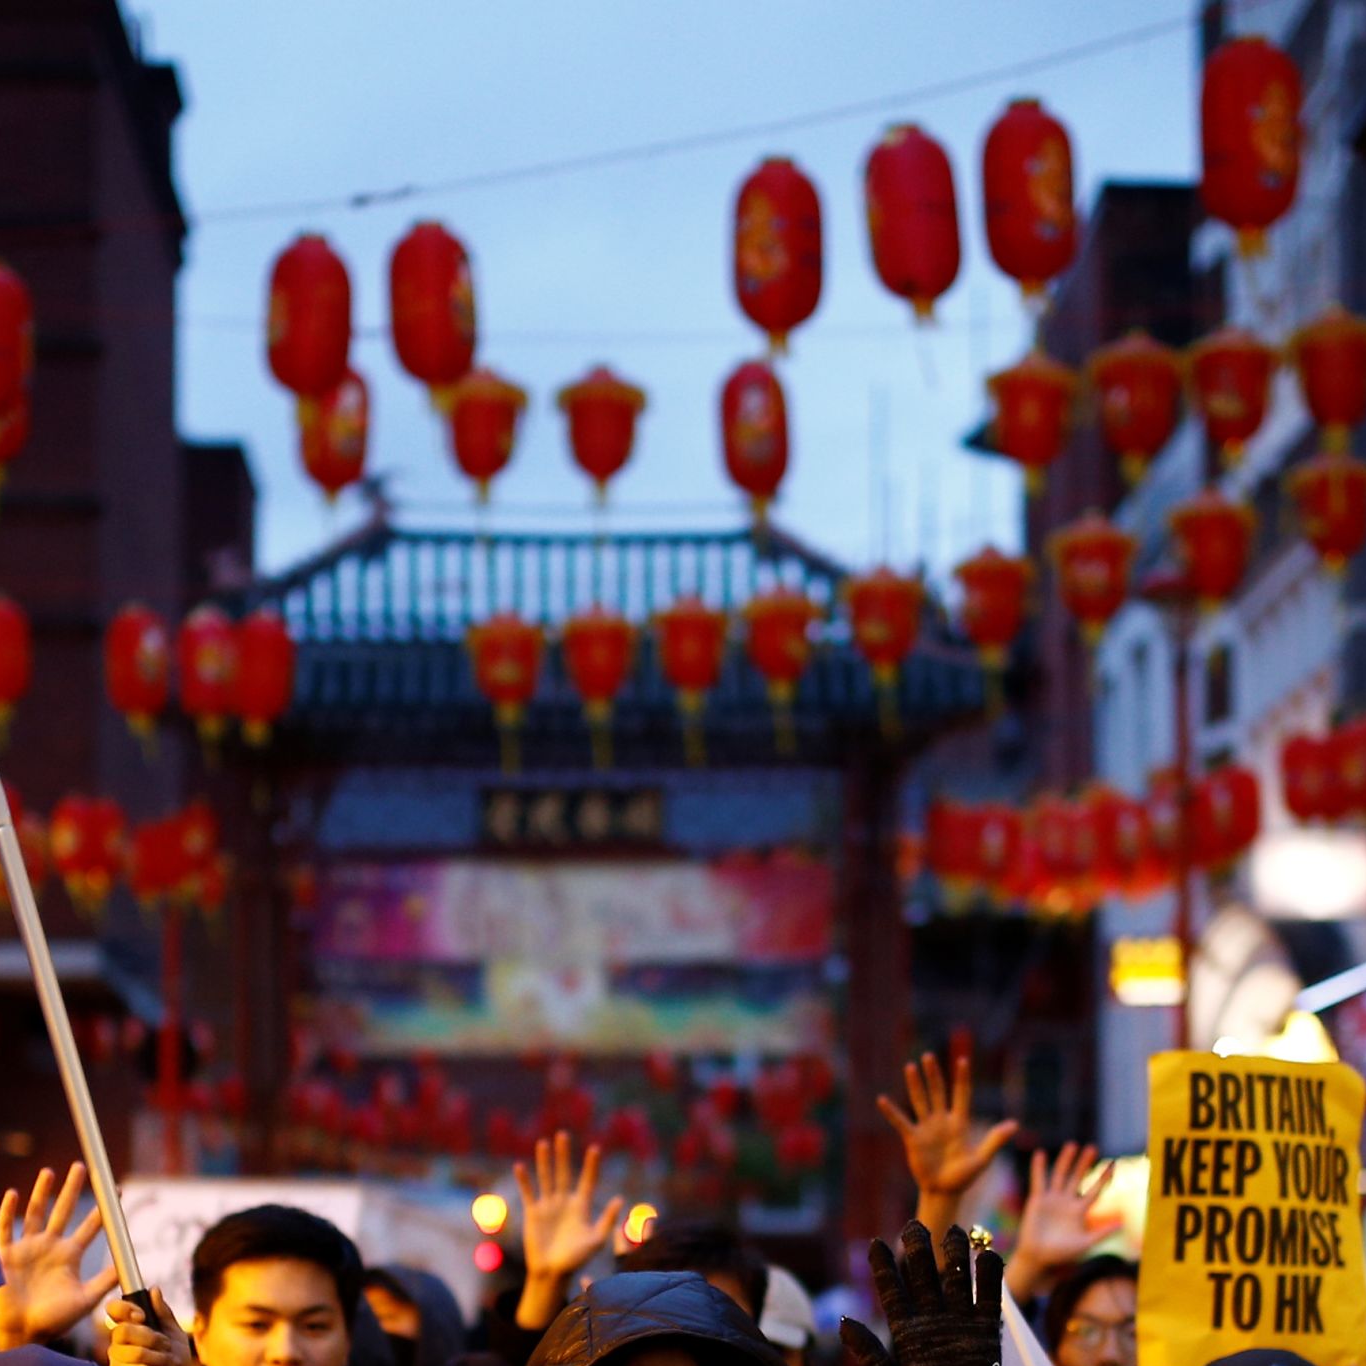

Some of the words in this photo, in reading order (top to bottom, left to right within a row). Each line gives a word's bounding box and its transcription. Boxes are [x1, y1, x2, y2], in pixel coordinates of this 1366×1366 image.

[1189, 1071, 1336, 1141] BRITAIN,
[1162, 1137, 1262, 1198] KEEP
[1273, 1141, 1350, 1206] YOUR
[1174, 1205, 1347, 1268] PROMISE
[1207, 1272, 1263, 1331] TO
[1274, 1274, 1324, 1334] HK
